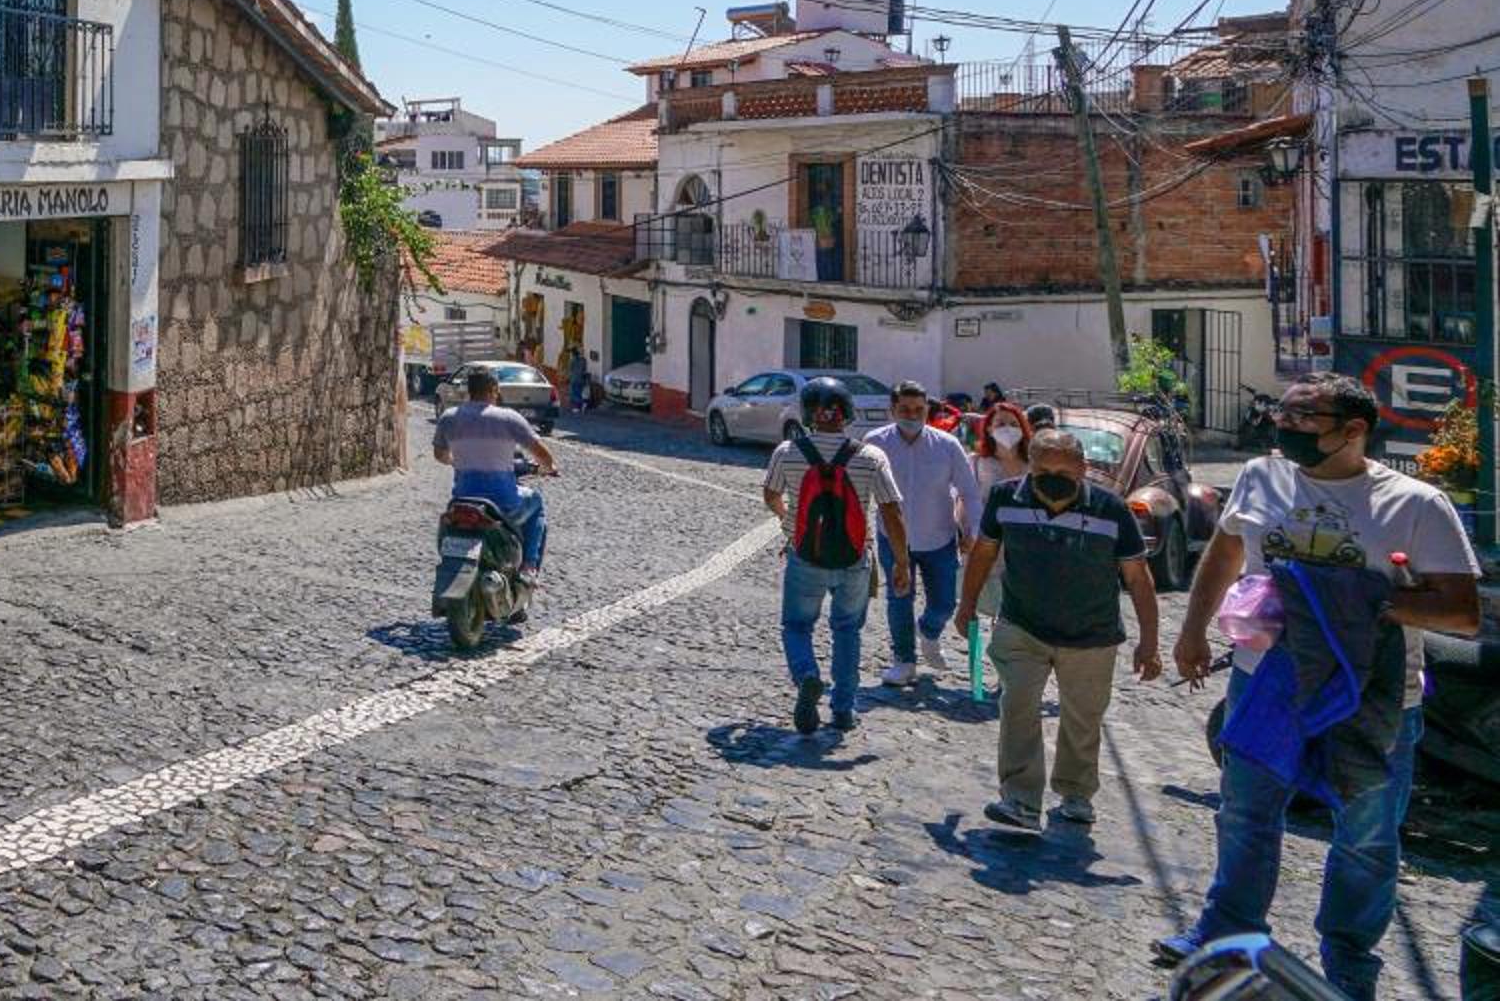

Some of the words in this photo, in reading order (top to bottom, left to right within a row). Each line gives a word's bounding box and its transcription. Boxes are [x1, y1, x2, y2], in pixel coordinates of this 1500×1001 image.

[1395, 135, 1500, 172] EST
[861, 160, 924, 185] DENTISTA
[37, 187, 110, 216] MANOLO
[917, 188, 925, 201] 2
[1391, 365, 1453, 413] E
